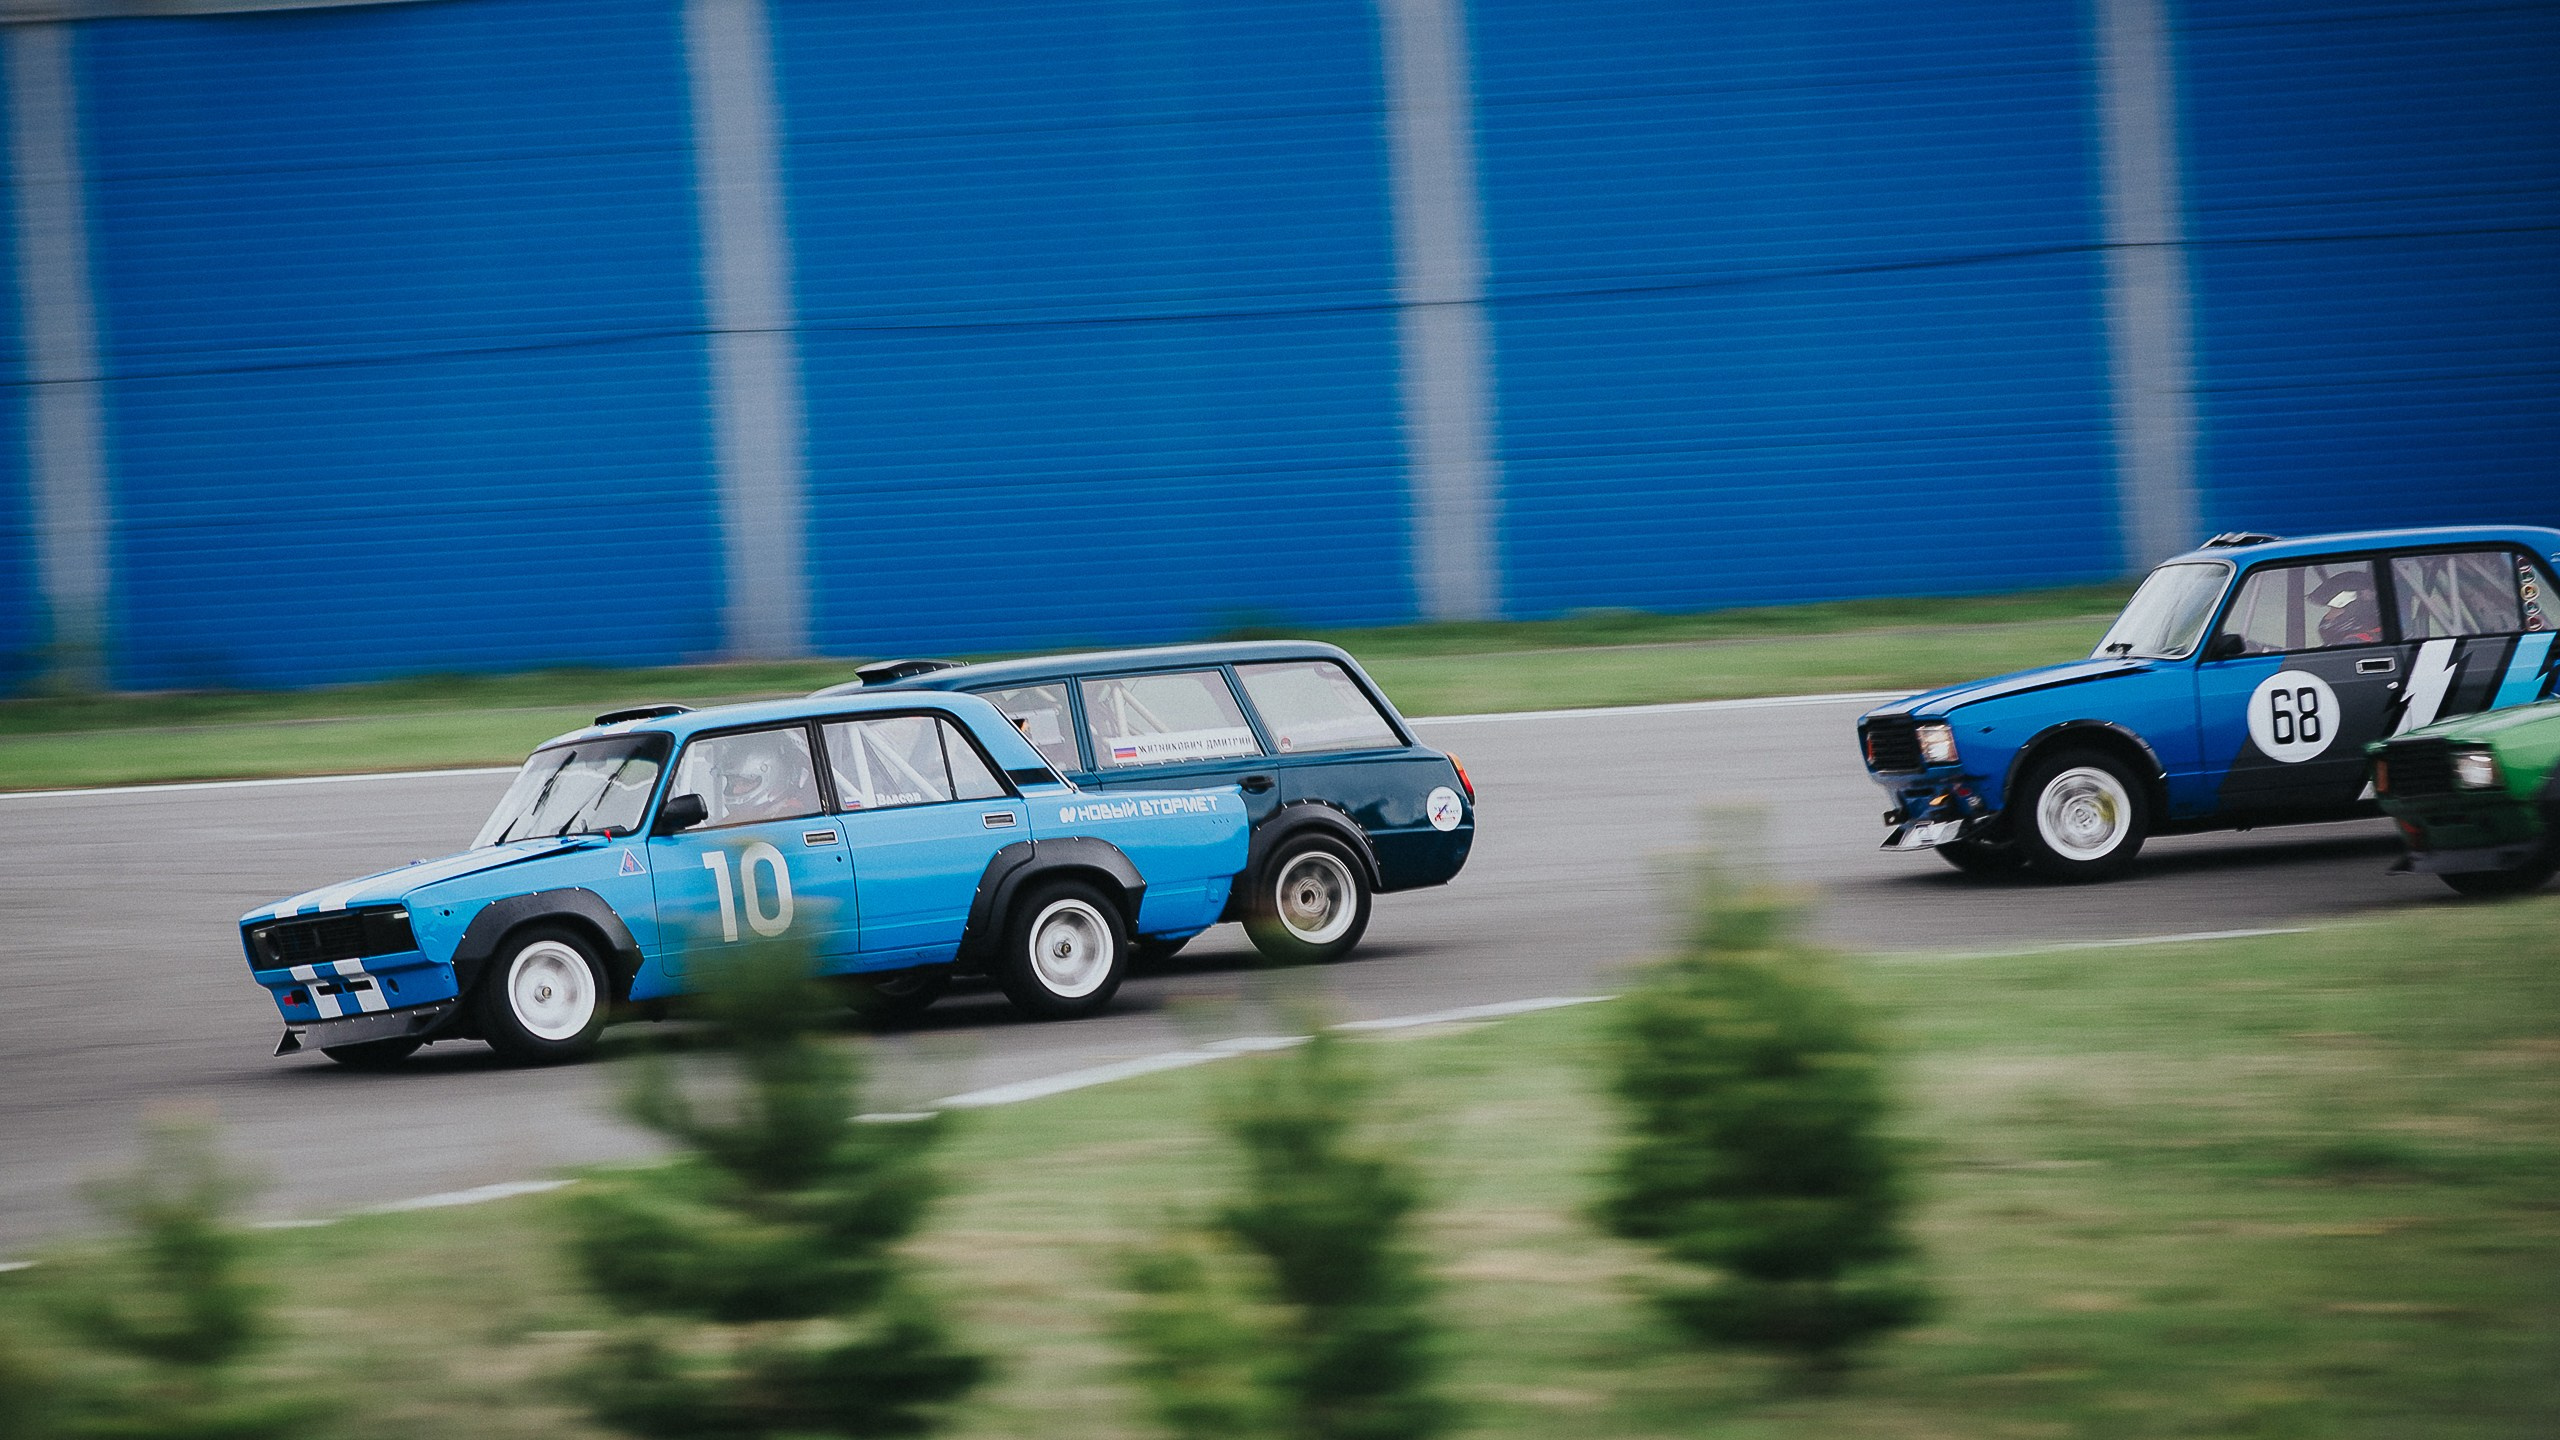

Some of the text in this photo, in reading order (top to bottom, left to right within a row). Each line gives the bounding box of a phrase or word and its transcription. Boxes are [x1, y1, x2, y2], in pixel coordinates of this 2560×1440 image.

[2271, 687, 2321, 744] 68
[1077, 796, 1218, 822] НОВЫЙ ВТОРМЕТ
[702, 841, 794, 943] 10
